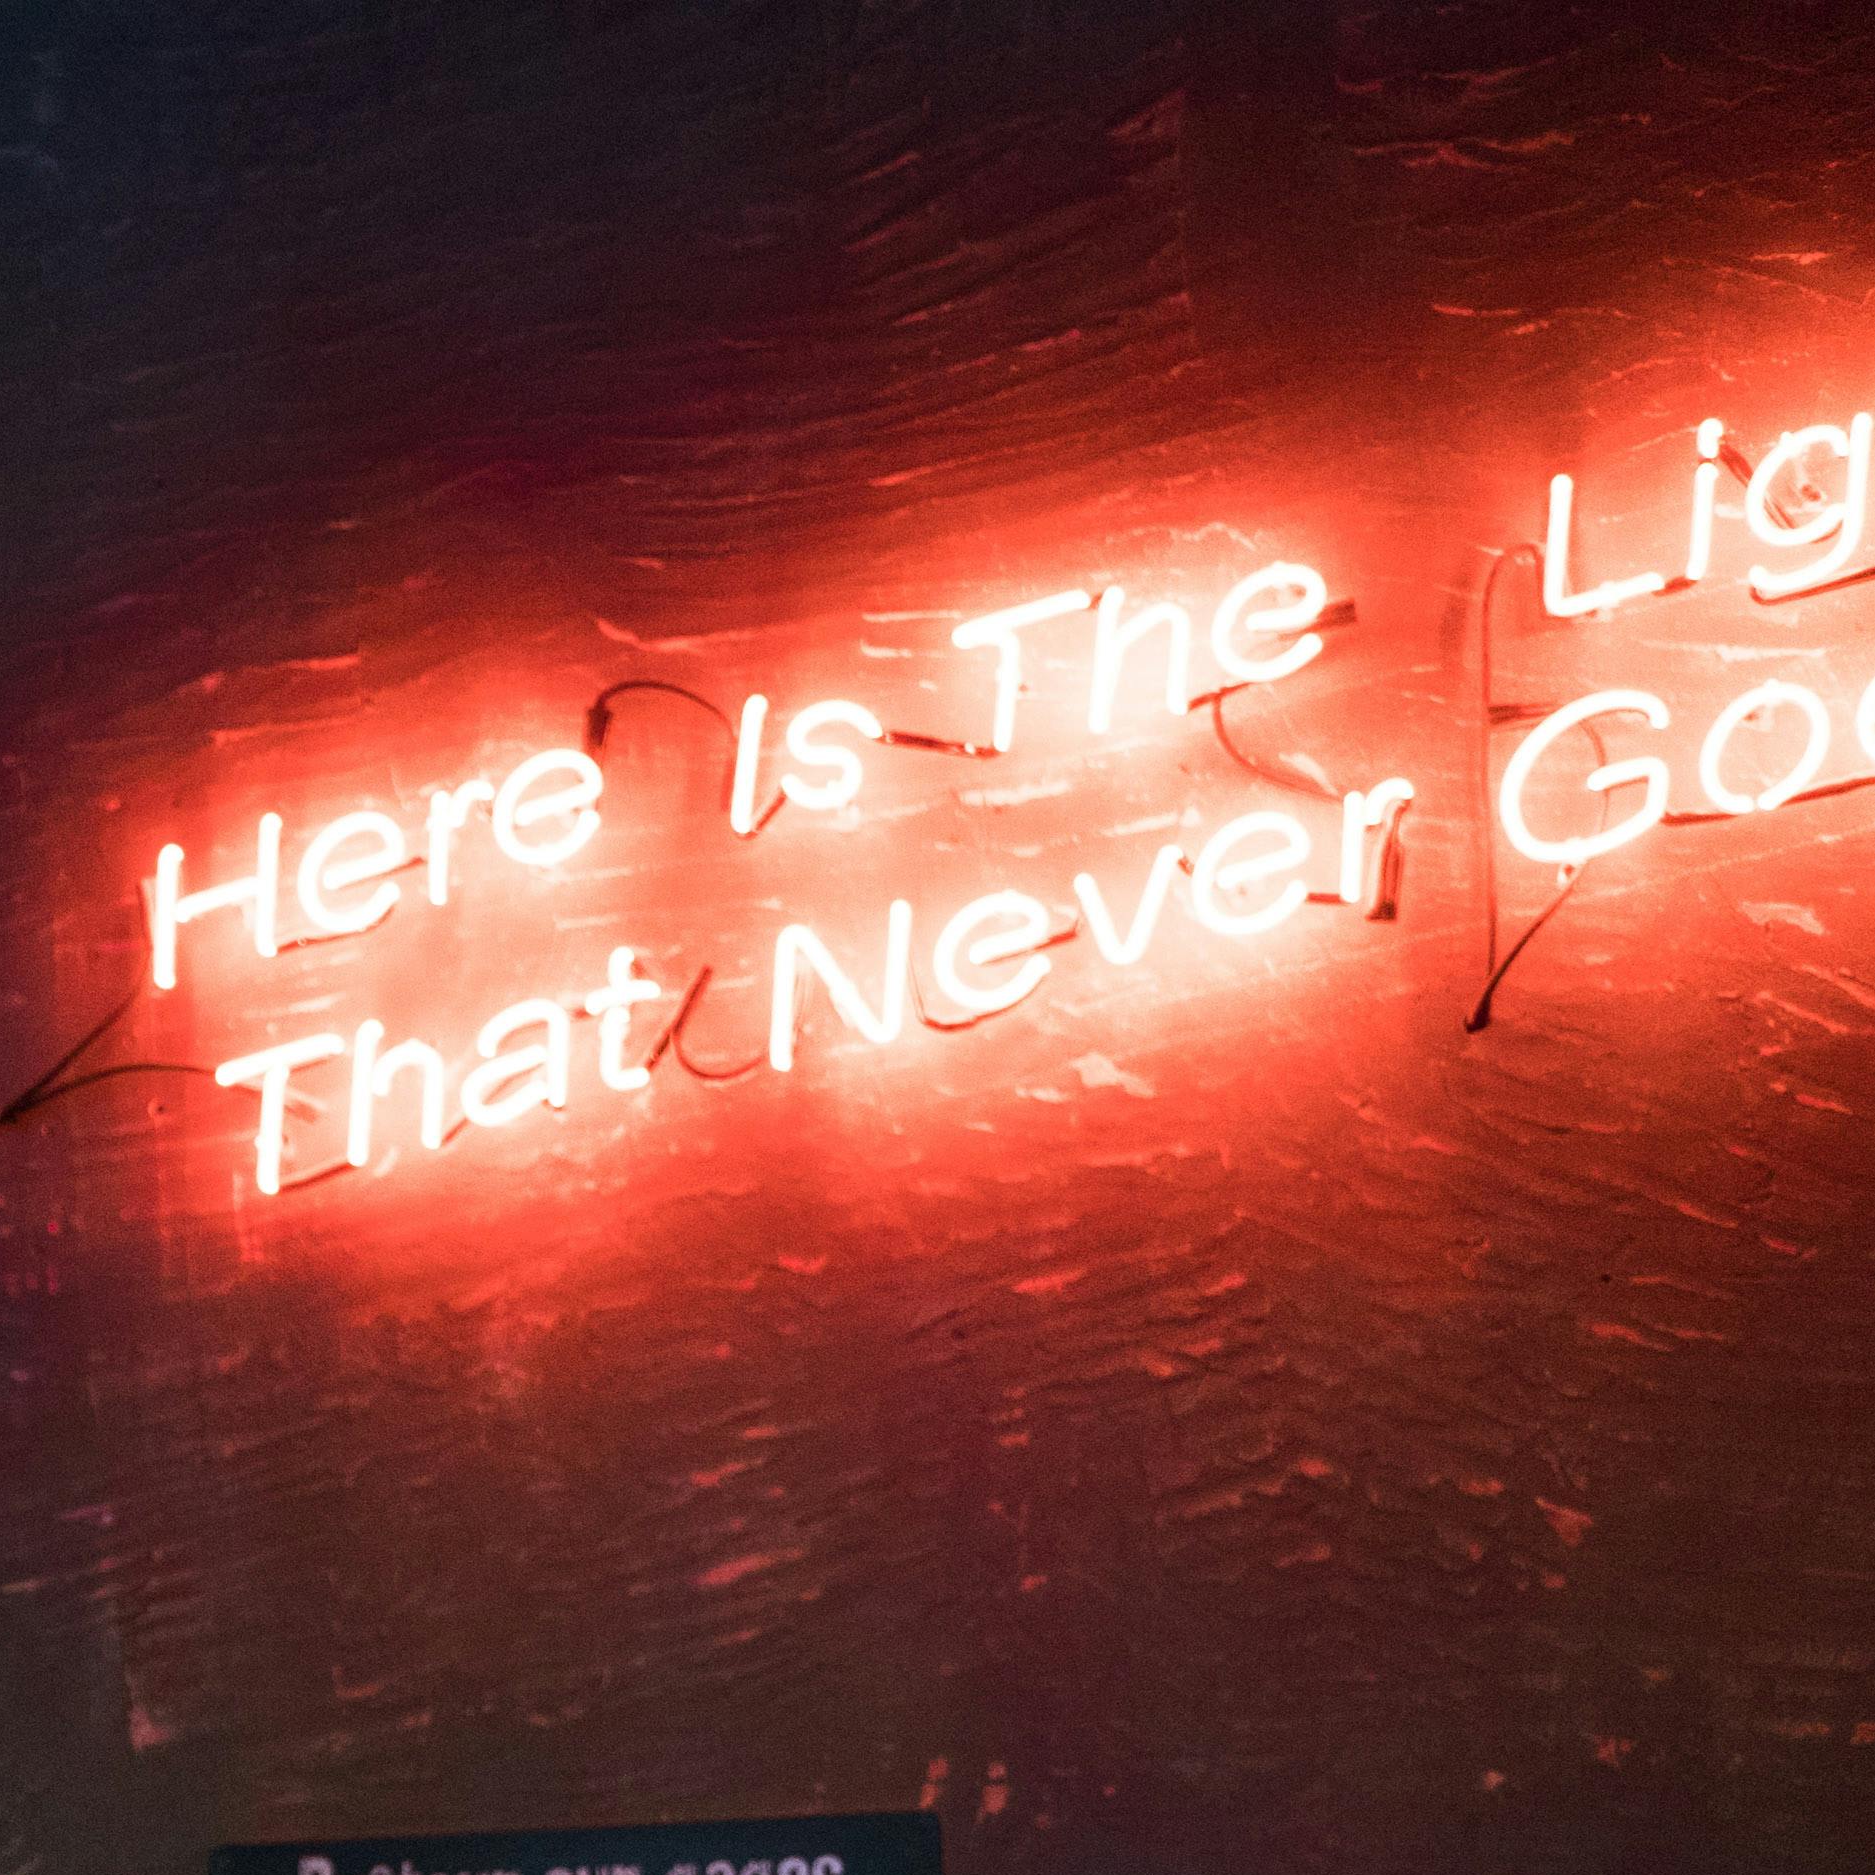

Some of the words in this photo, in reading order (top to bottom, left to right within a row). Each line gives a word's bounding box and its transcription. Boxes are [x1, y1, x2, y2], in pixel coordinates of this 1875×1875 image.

[149, 744, 604, 992] Here
[730, 692, 888, 836] Is
[951, 561, 1329, 753] The
[1543, 416, 1875, 617] Lig
[214, 946, 662, 1197] That
[768, 776, 1415, 1073] Never
[1498, 676, 1875, 863] Go
